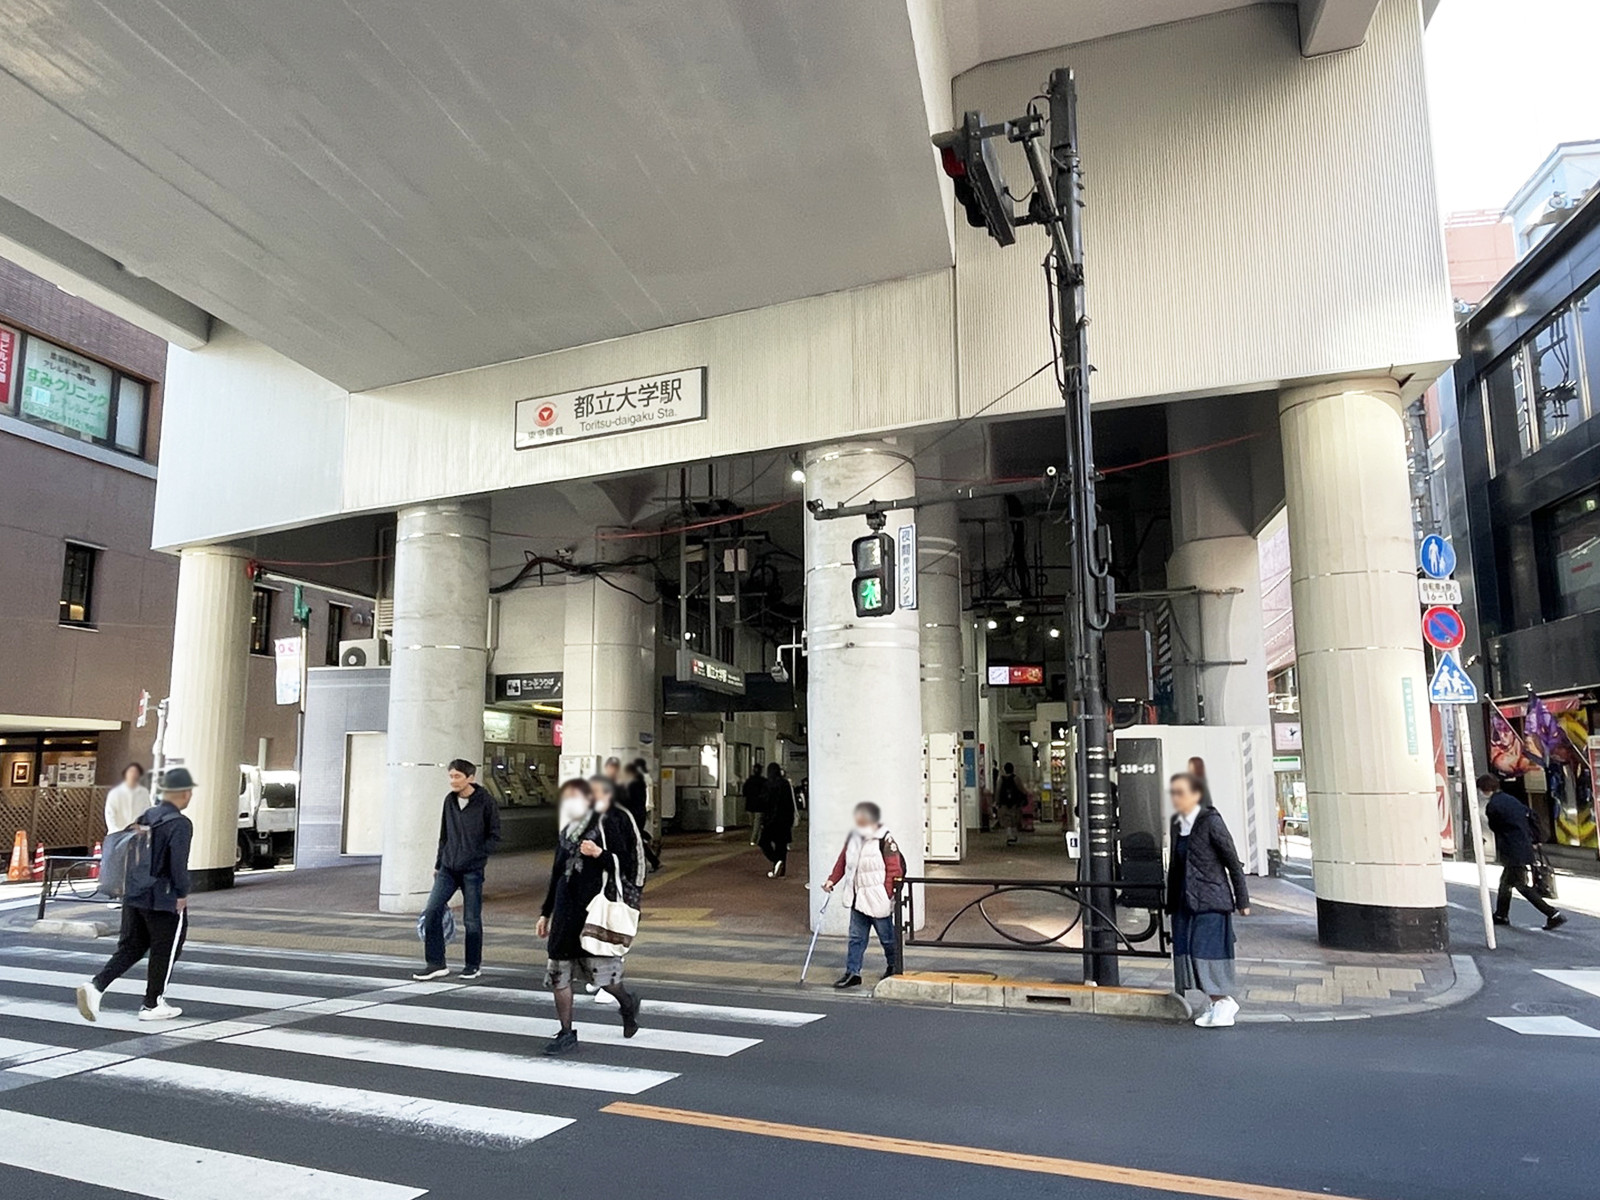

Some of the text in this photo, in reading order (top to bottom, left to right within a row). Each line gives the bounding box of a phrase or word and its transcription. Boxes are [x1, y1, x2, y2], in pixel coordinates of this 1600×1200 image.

[26, 366, 109, 407] すみクリニック
[574, 378, 682, 420] 都立大学駅
[580, 407, 678, 433] Toritsu-daigaku Sta.
